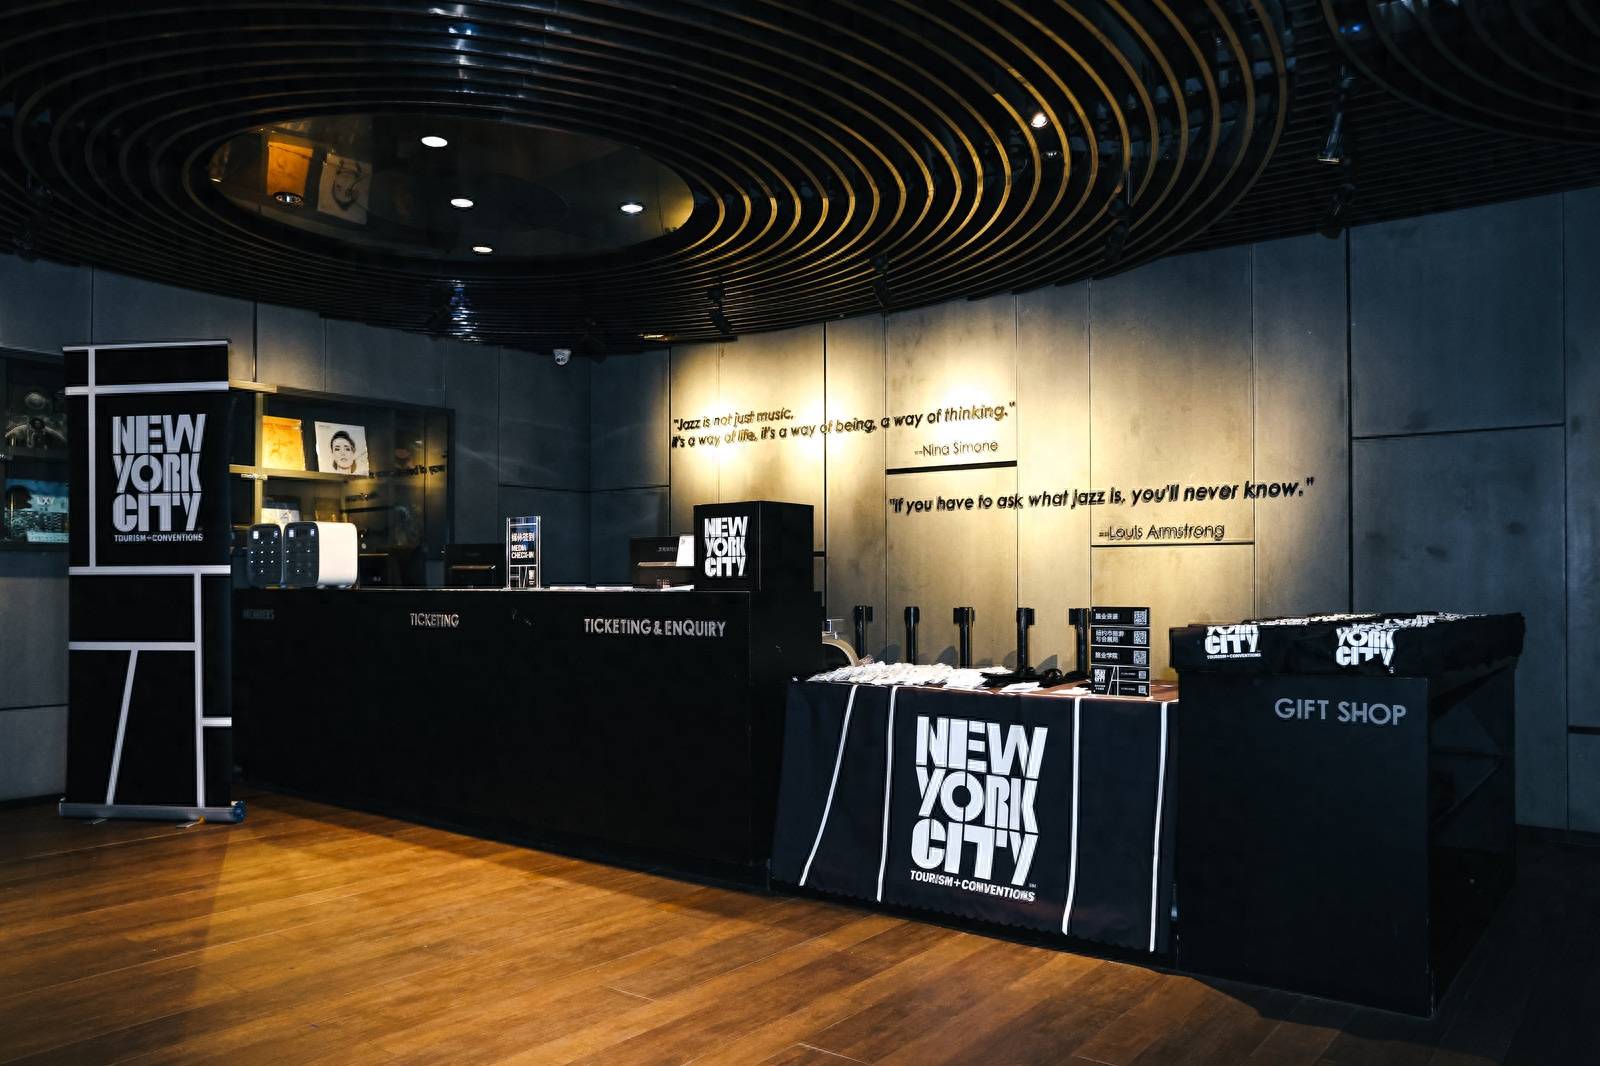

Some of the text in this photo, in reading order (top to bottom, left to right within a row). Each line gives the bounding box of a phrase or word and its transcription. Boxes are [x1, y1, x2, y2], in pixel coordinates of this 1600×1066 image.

[112, 413, 208, 454] NEW
[687, 436, 696, 447] a
[698, 434, 721, 448] way
[724, 429, 737, 444] of
[760, 426, 776, 440] it's
[778, 427, 788, 439] a
[790, 424, 817, 439] way
[819, 420, 834, 434] of
[881, 416, 890, 428] a
[894, 413, 923, 429] way
[927, 408, 942, 424] of
[702, 416, 711, 428] is
[713, 413, 732, 426] not
[733, 410, 756, 428] just
[953, 440, 999, 455] Simone
[112, 453, 202, 493] YORK
[112, 493, 202, 532] CITY
[906, 498, 933, 516] you
[936, 496, 975, 513] have
[978, 493, 994, 510] to
[996, 493, 1024, 510] ask
[1028, 489, 1069, 508] what
[1070, 488, 1106, 510] jazz
[1131, 484, 1179, 507] you'll
[1183, 484, 1239, 502] never
[704, 515, 748, 538] NEW
[1145, 523, 1225, 542] Armstrong
[704, 537, 746, 558] YORK
[704, 557, 746, 578] CITY
[409, 612, 460, 629] TICKETING
[1204, 634, 1259, 655] CITY
[1335, 645, 1395, 667] CITY
[1274, 697, 1407, 726] GIFT SHOP
[915, 715, 1049, 780] NEW
[915, 766, 1040, 834] YORK
[911, 818, 1040, 887] CITY
[910, 869, 1036, 902] TOURISM+CONVENTIONS
